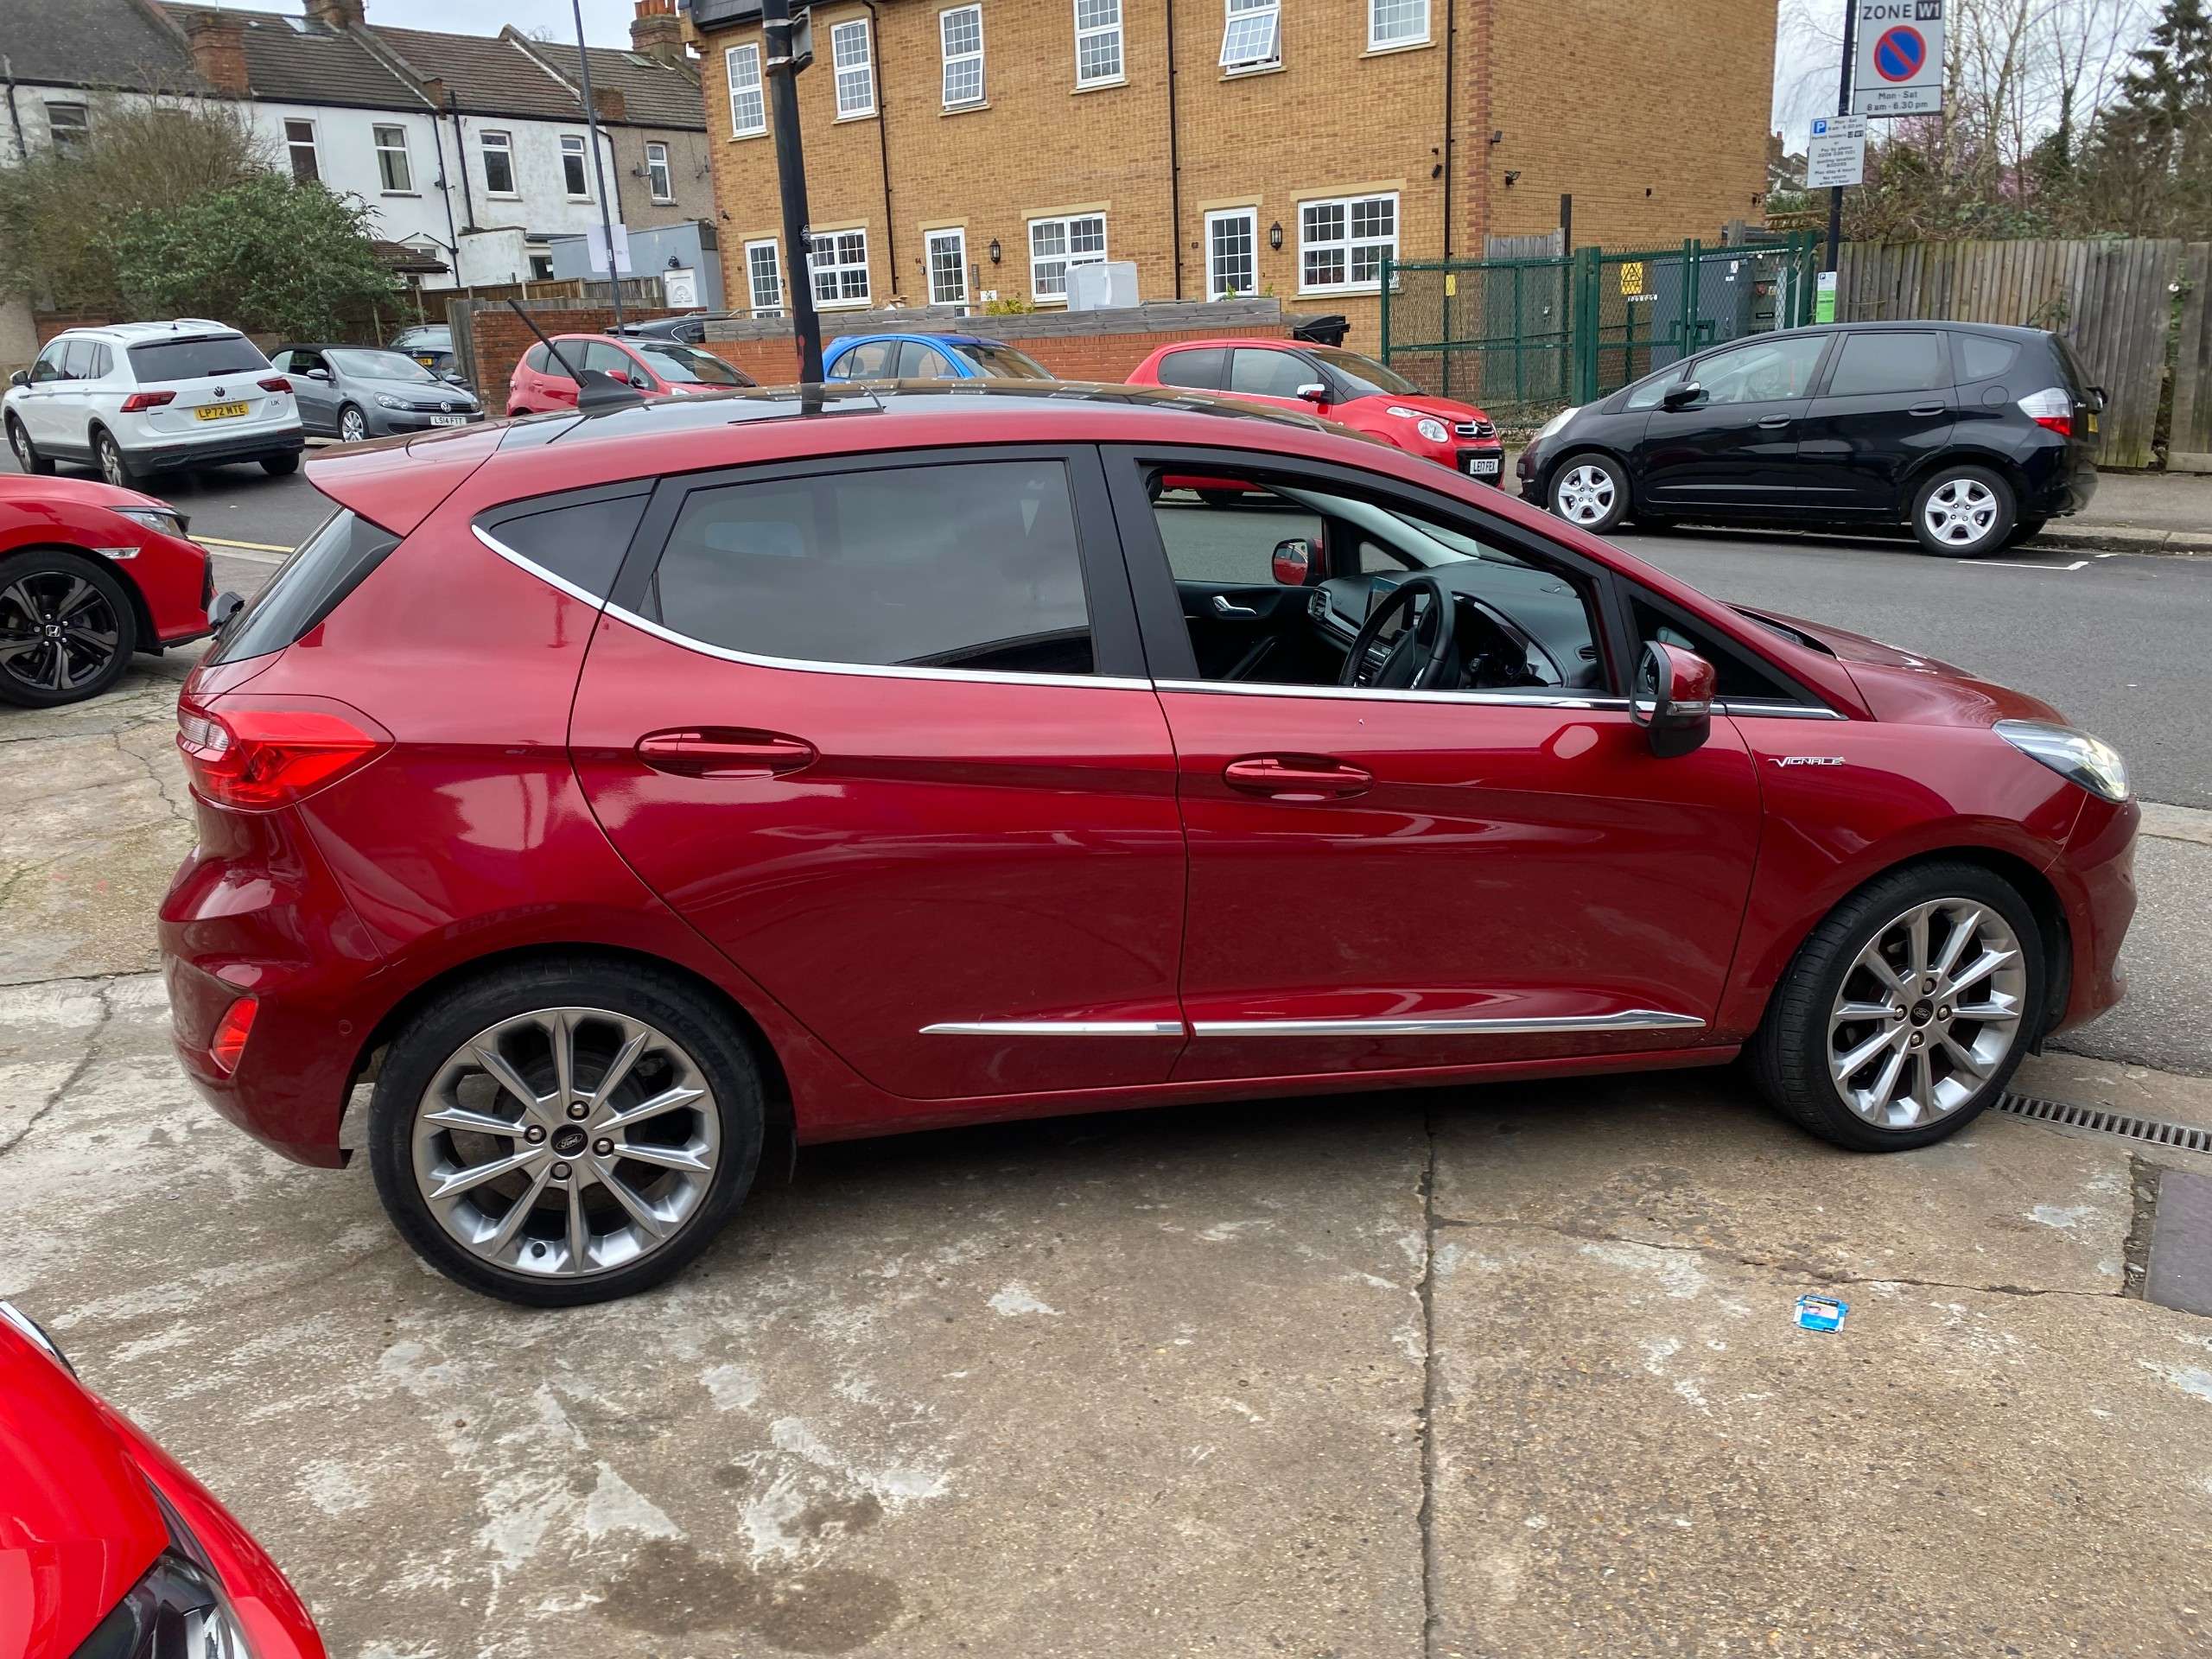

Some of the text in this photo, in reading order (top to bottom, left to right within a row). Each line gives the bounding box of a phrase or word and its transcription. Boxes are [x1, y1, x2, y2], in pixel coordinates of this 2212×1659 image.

[1863, 3, 1941, 20] ZONE W1
[1893, 101, 1914, 110] 6.30
[198, 407, 225, 418] LP72
[1768, 756, 1846, 767] VIGNALE
